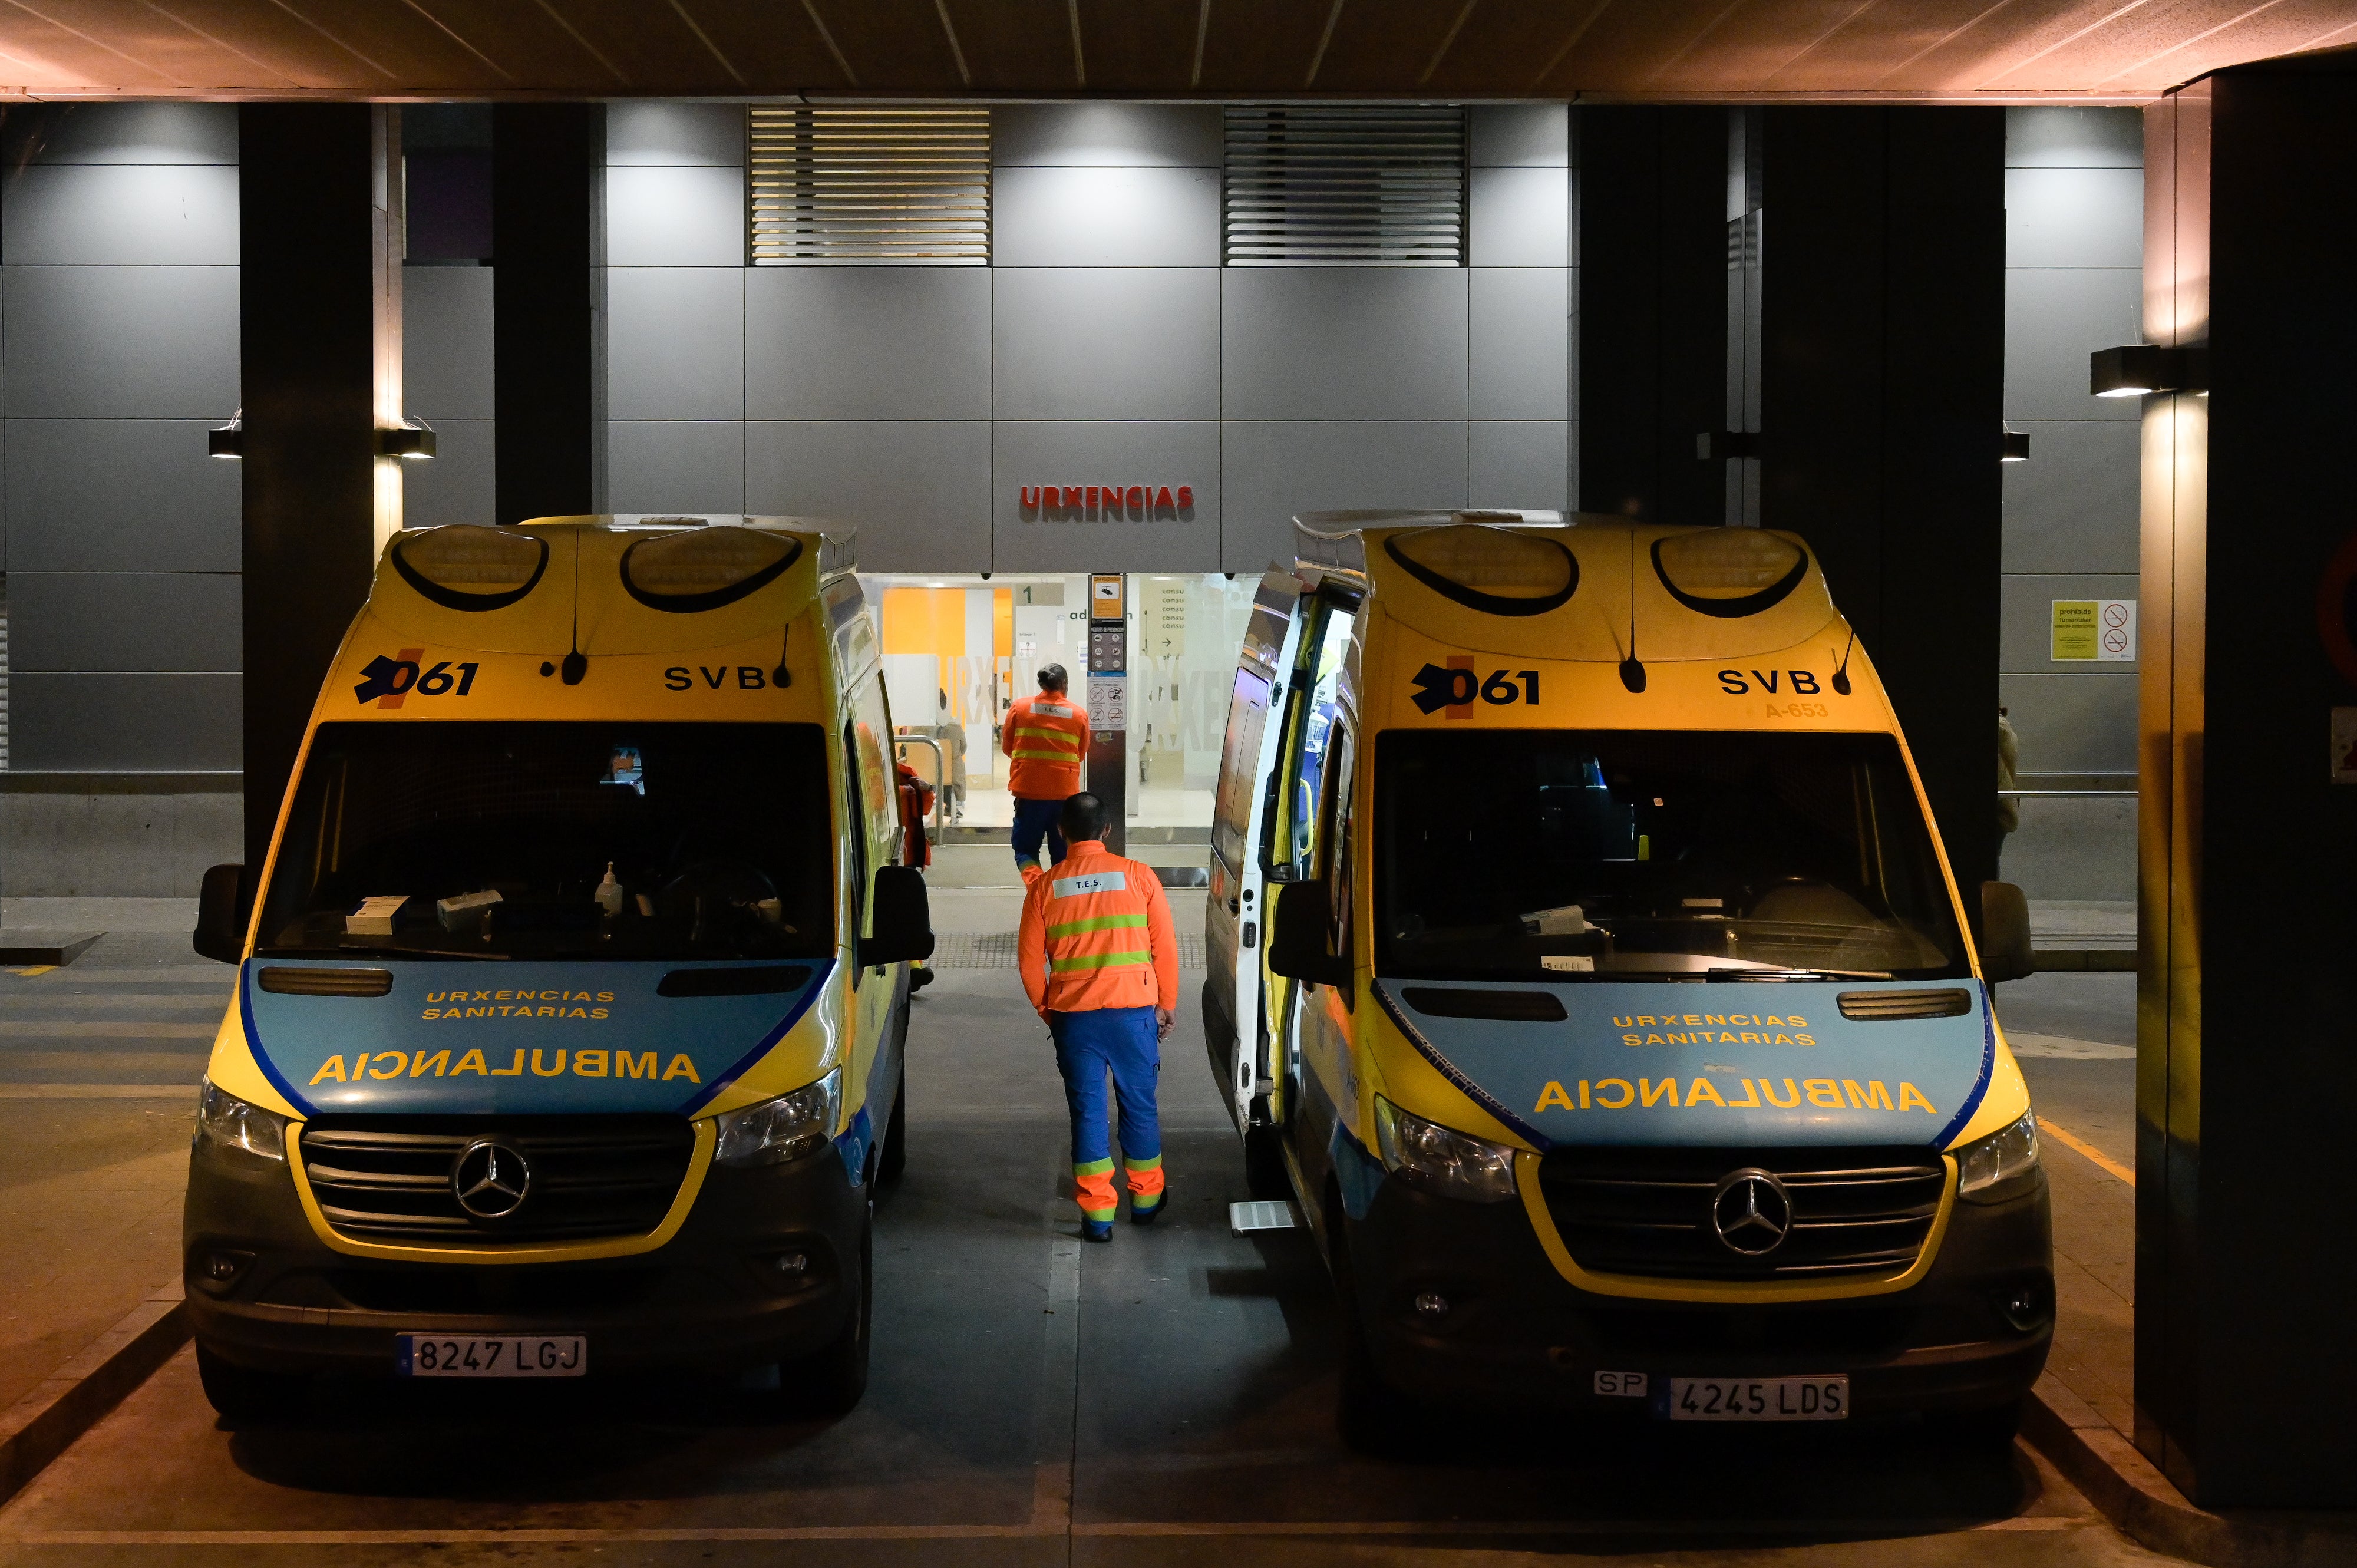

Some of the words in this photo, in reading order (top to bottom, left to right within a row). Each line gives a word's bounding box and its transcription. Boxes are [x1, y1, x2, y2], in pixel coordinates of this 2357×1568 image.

[1021, 486, 1194, 509] URXENCIAS
[1023, 586, 1031, 603] 1
[389, 661, 479, 697] 061
[663, 666, 766, 691] SVB
[1447, 669, 1540, 705] 061
[1717, 669, 1821, 695] SVB
[1766, 702, 1830, 719] A-653
[1075, 879, 1102, 889] T.E.S.
[426, 990, 615, 1003] URXENCIAS
[421, 1006, 609, 1020] SANITARIAS
[1612, 1015, 1808, 1028] URXENCIAS
[1622, 1031, 1817, 1047] SANITARIAS
[420, 1341, 503, 1371] 8247
[516, 1341, 579, 1370] LGJ
[1599, 1373, 1643, 1393] SP
[1681, 1384, 1765, 1414] 4245
[1779, 1384, 1840, 1414] LDS
